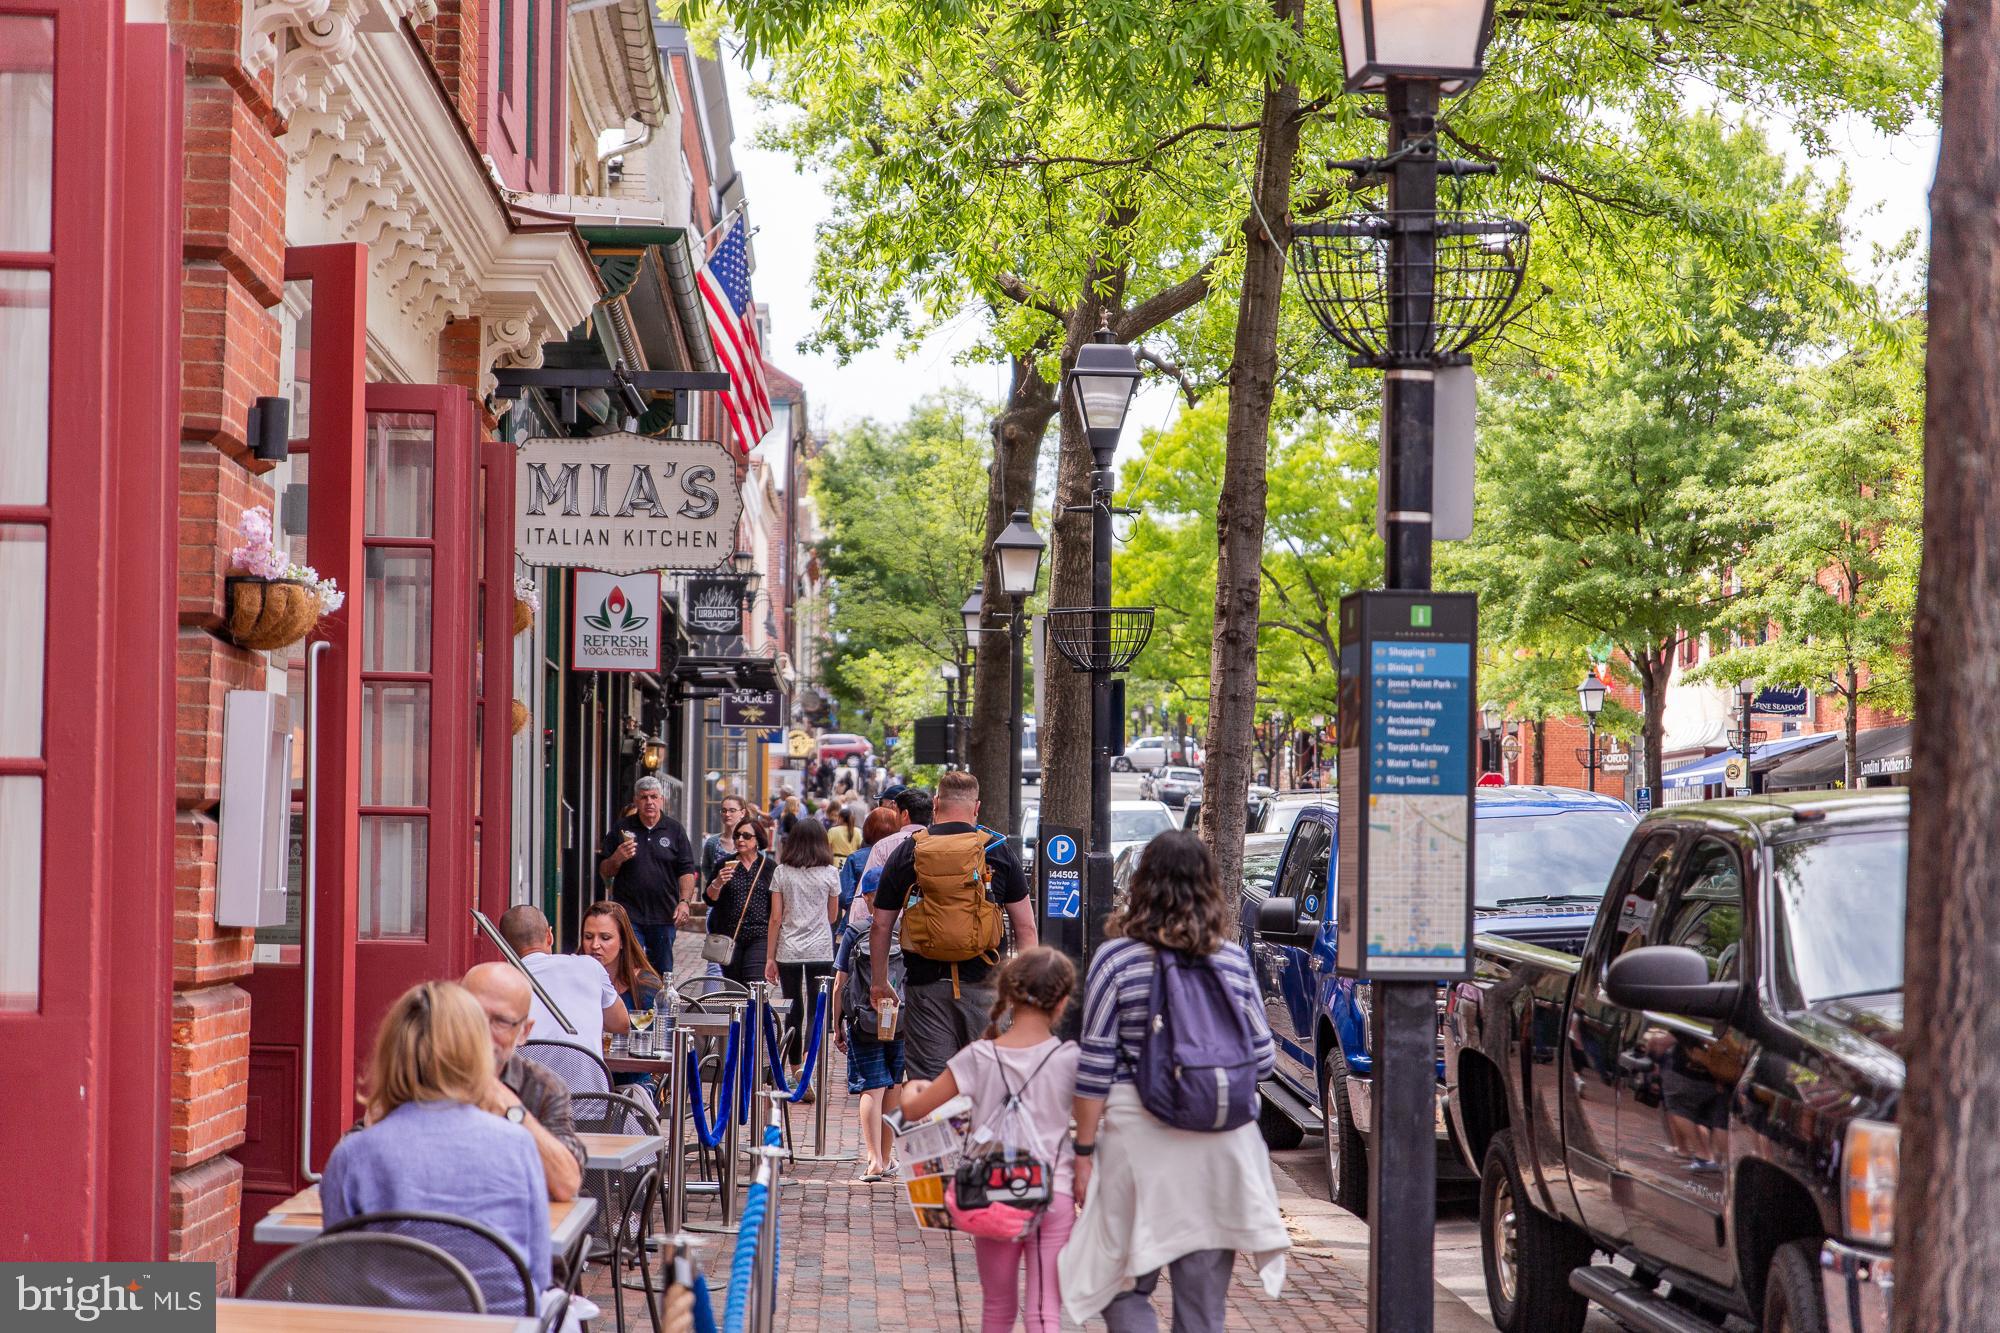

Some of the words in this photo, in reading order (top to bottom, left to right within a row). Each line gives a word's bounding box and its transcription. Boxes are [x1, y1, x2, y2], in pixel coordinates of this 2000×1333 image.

[526, 462, 719, 519] MIA'S
[526, 527, 610, 546] ITALIAN
[624, 529, 718, 548] KITCHEN
[583, 634, 649, 648] REFRESH
[583, 647, 610, 656] YOGA
[611, 647, 649, 657] CENTER
[1388, 647, 1426, 658] Shopping
[1387, 663, 1413, 674] Dining
[1433, 679, 1451, 689] Park
[1424, 700, 1442, 710] Park
[1755, 702, 1772, 710] FINE
[1772, 703, 1805, 711] SEAFOOD
[1056, 840, 1069, 860] P
[1049, 870, 1079, 879] 144502
